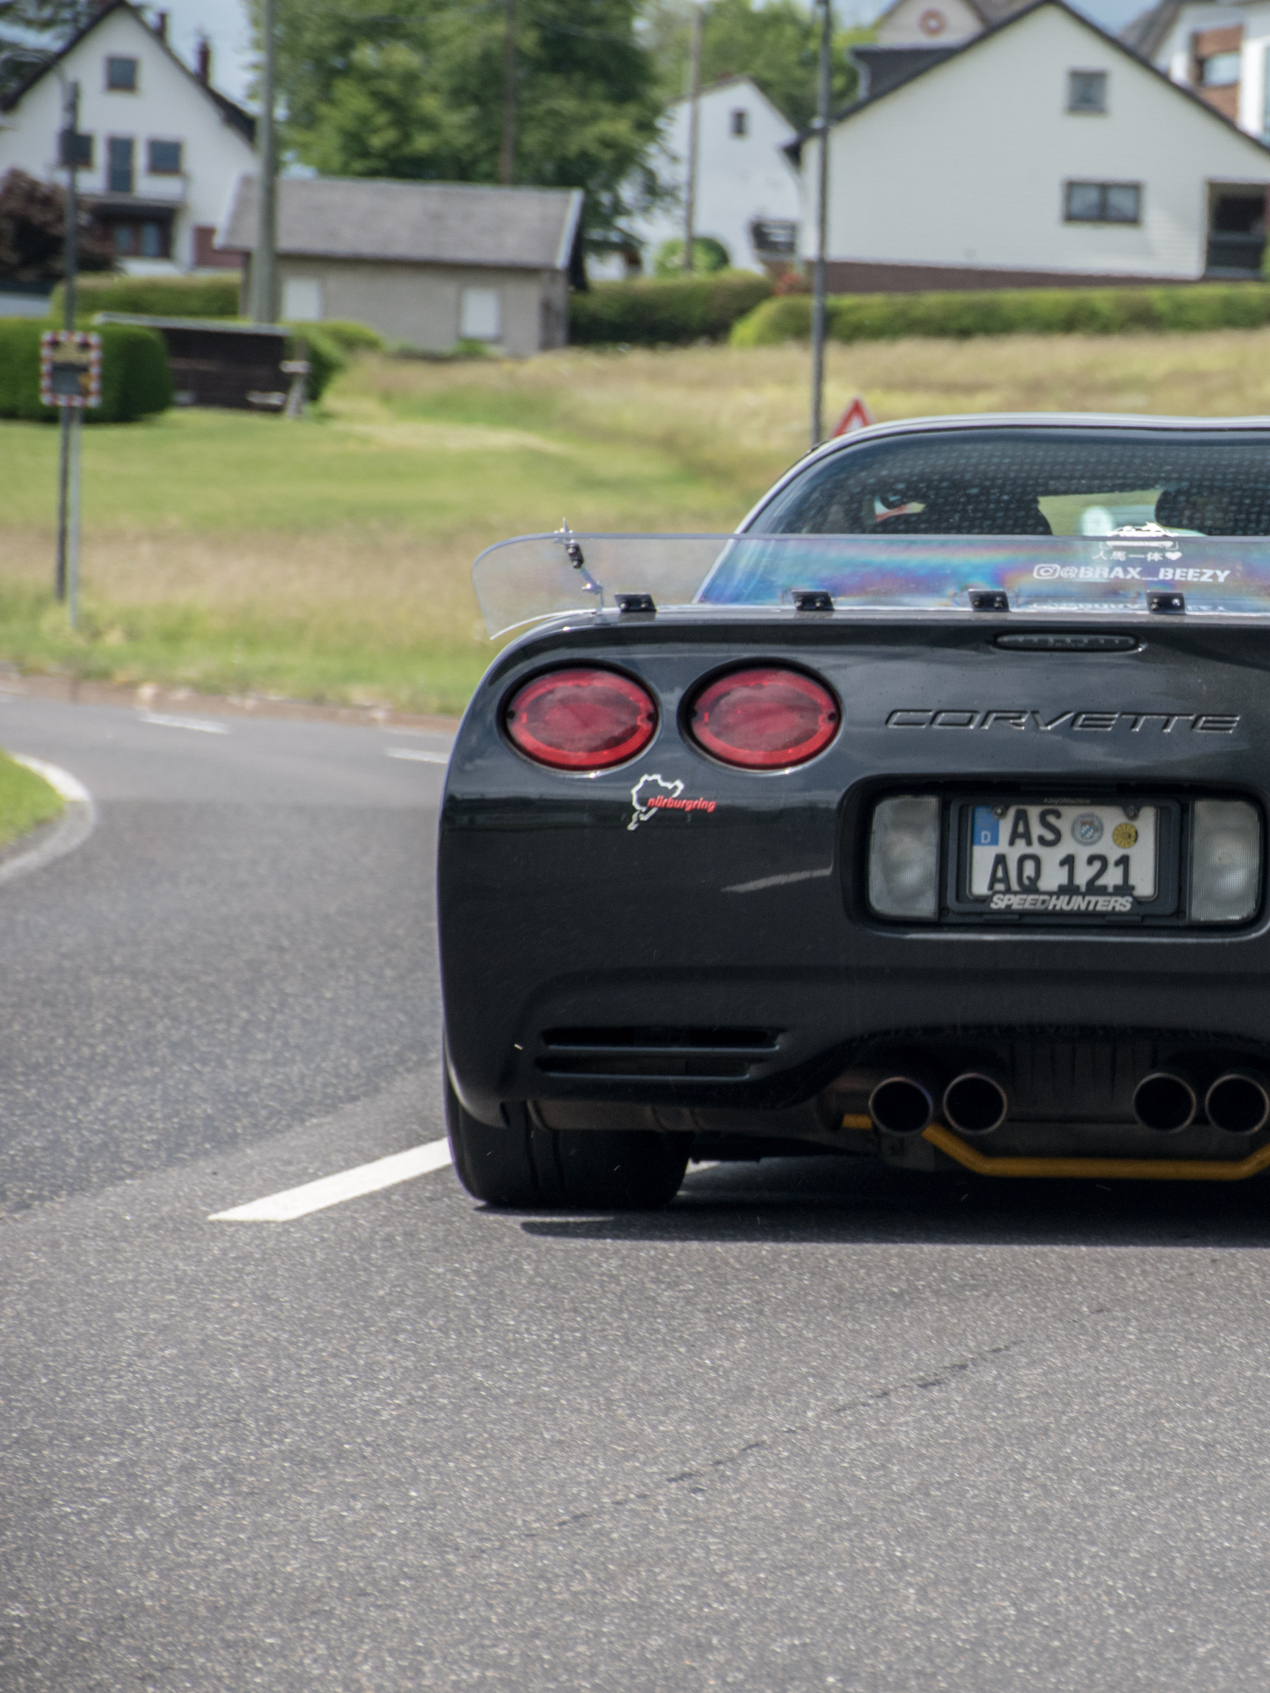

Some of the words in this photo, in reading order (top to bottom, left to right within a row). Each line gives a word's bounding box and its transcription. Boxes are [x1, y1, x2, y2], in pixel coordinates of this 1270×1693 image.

[885, 709, 1241, 733] CORVETTE
[982, 832, 991, 844] D
[1008, 808, 1062, 847] AS
[987, 853, 1042, 892] AQ
[1058, 854, 1136, 893] 121
[990, 895, 1133, 912] SPEEDHUNTERS
